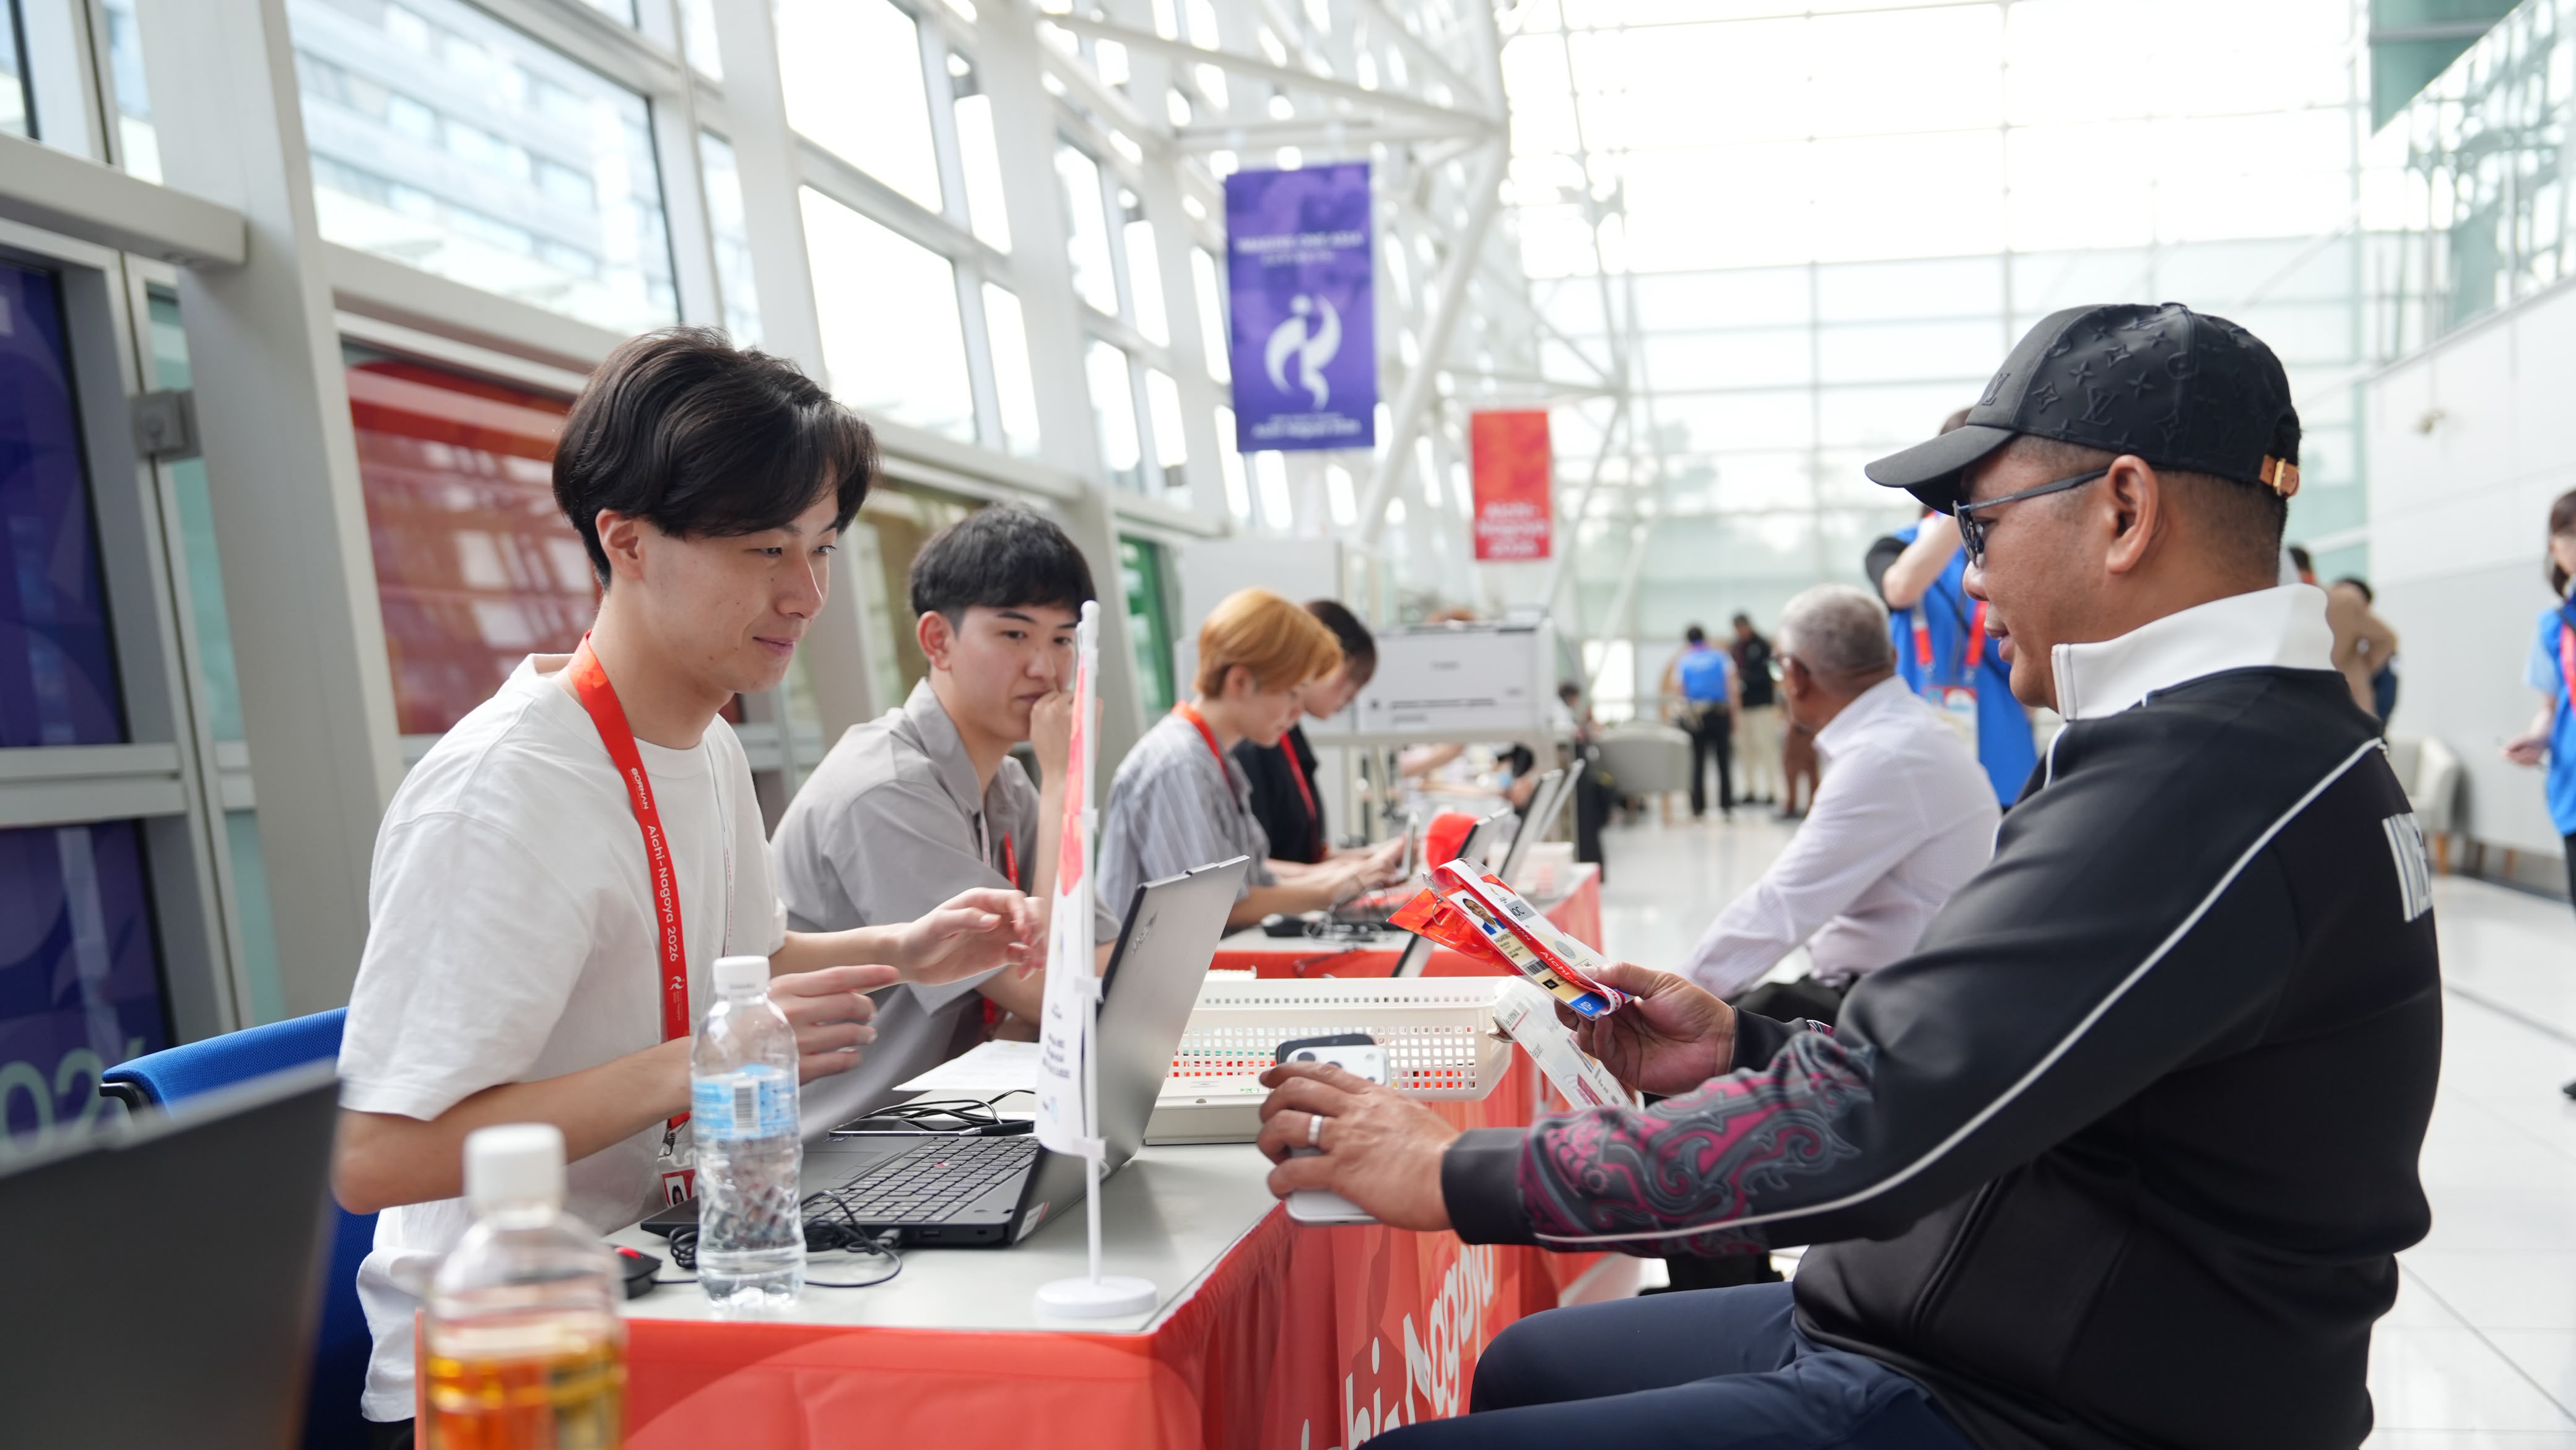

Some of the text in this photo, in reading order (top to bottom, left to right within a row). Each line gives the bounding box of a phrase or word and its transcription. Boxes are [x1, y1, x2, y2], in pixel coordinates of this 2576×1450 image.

[631, 767, 650, 810] BORNAN
[647, 825, 679, 962] Aichi-Nagoya 2026
[1577, 1001, 1594, 1012] VIP
